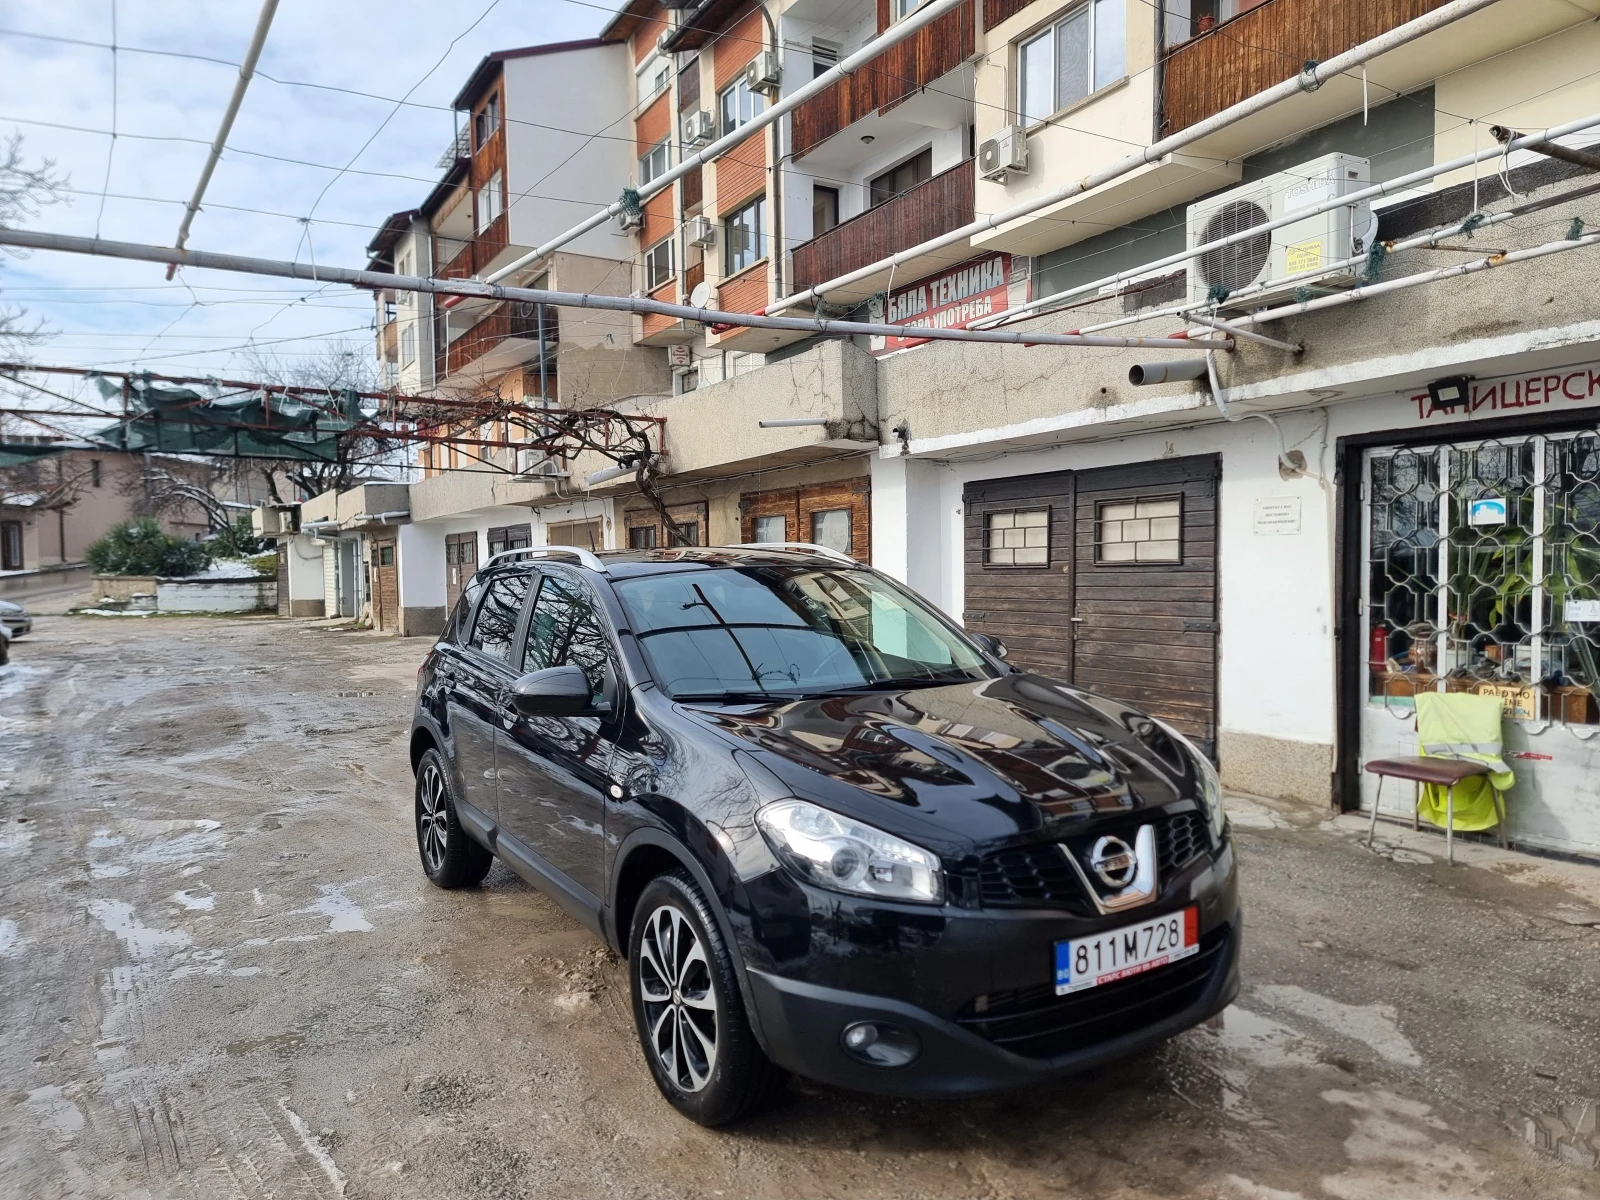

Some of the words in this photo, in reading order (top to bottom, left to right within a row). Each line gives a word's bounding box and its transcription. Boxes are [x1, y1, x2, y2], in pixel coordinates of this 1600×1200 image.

[1286, 174, 1336, 199] TOSHIBA
[887, 285, 928, 325] БЯЛА
[930, 256, 1005, 309] ТЕХНИКА
[932, 295, 992, 329] УПОТРЕБА
[1410, 369, 1600, 419] ТАИЦЕРСК
[1075, 919, 1179, 975] 811M728
